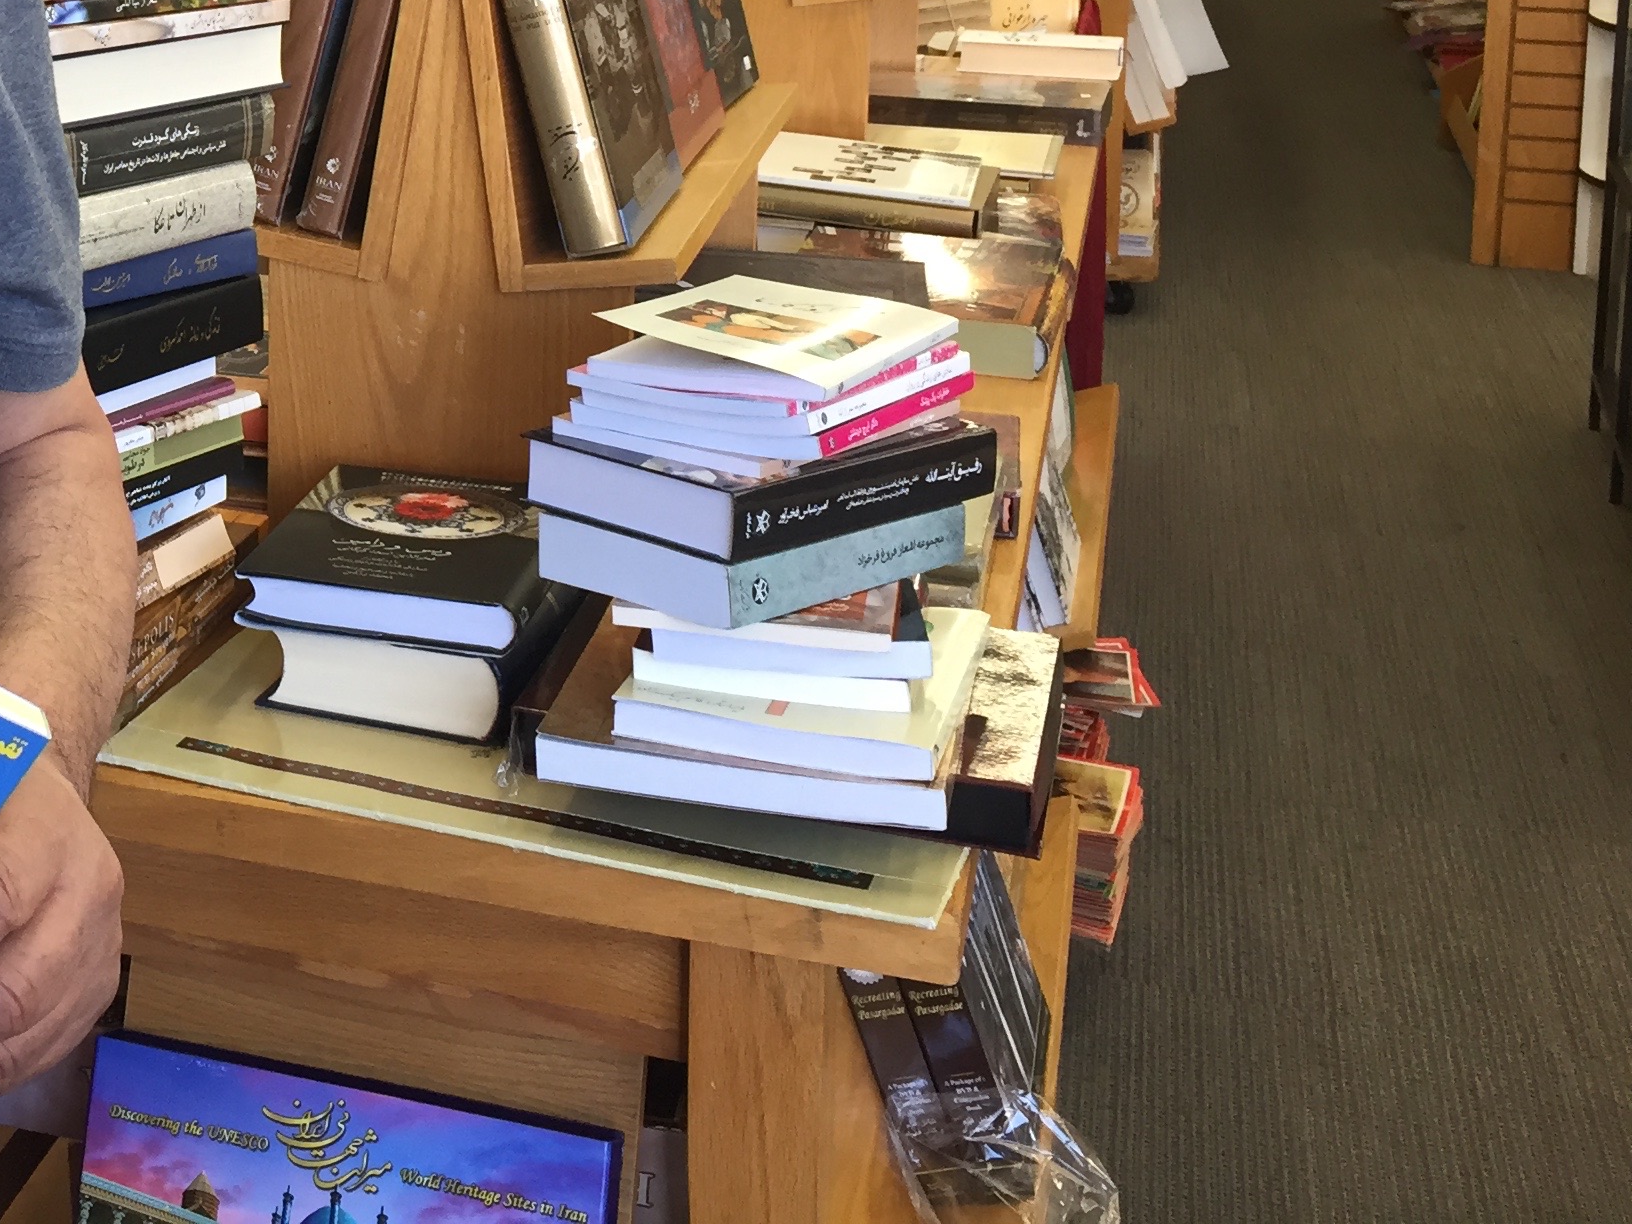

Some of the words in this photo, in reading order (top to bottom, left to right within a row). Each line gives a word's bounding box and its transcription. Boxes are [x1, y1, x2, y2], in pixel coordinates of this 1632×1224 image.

[253, 163, 279, 179] IRAN
[315, 175, 342, 191] IRAN
[153, 206, 166, 235] عکا
[176, 195, 198, 232] طهران
[196, 202, 207, 224] از
[953, 457, 983, 483] رفیق
[916, 535, 946, 552] مجموعه
[880, 546, 900, 564] فروغ
[850, 989, 902, 1008] Recreating
[907, 985, 960, 1004] Recreating
[857, 1005, 906, 1021] Pasargadae
[914, 999, 964, 1017] Pasargadae
[109, 1104, 181, 1137] Discovering
[182, 1118, 205, 1137] the
[206, 1125, 271, 1152] UNESCO
[399, 1167, 443, 1190] World
[443, 1177, 502, 1205] Heritage
[502, 1191, 537, 1213] Sites
[539, 1200, 555, 1216] in
[556, 1203, 589, 1223] Iran
